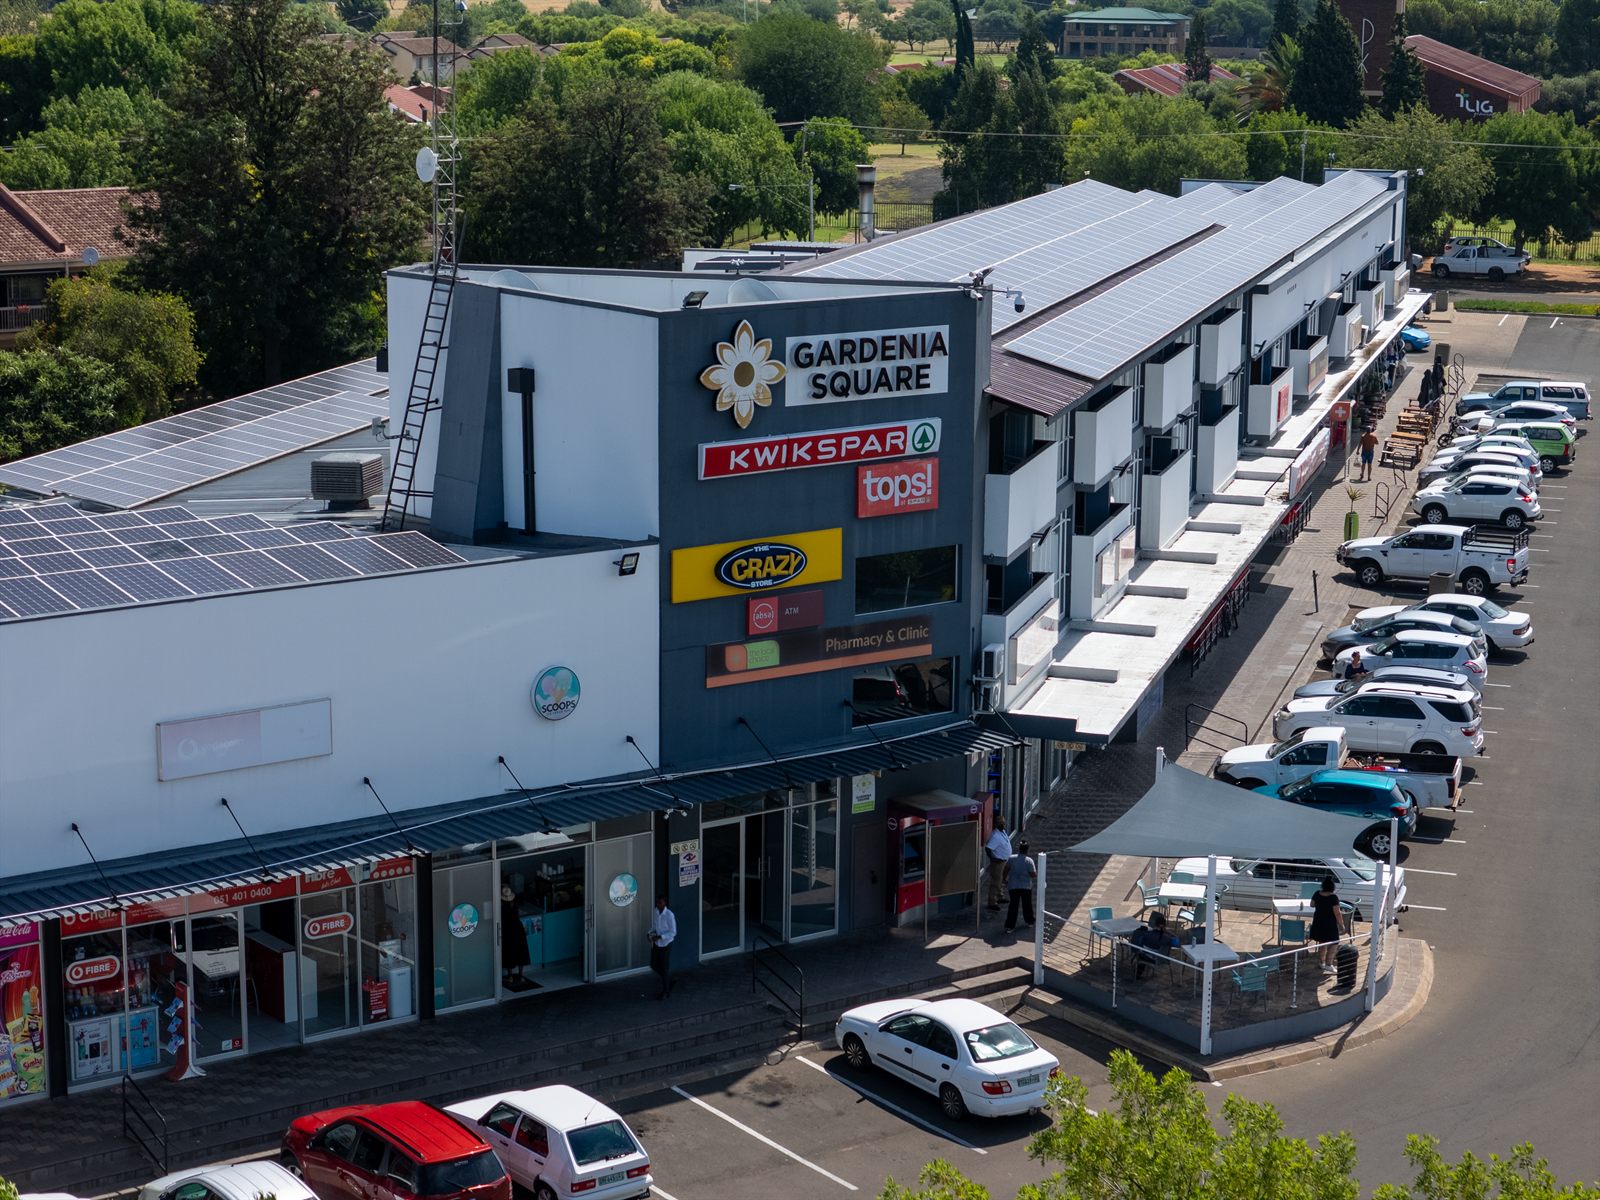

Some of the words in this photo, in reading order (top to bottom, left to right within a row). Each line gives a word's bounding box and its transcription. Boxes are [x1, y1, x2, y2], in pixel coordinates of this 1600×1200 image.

[794, 331, 949, 368] GARDENIA
[811, 363, 931, 399] SQUARE
[729, 431, 904, 470] KWIKSPAR
[863, 463, 932, 507] tops!
[731, 552, 802, 582] CRAZY
[750, 579, 773, 588] STORE
[755, 608, 772, 620] absa
[784, 606, 799, 616] ATM
[825, 633, 884, 653] Pharmacy
[885, 629, 896, 643] &
[897, 625, 929, 642] Clinic
[541, 700, 576, 713] SCOOPS
[213, 894, 229, 905] 051
[232, 891, 248, 901] 401
[250, 886, 272, 898] 0400
[322, 919, 346, 931] FIBRE
[86, 962, 111, 975] FIBRE
